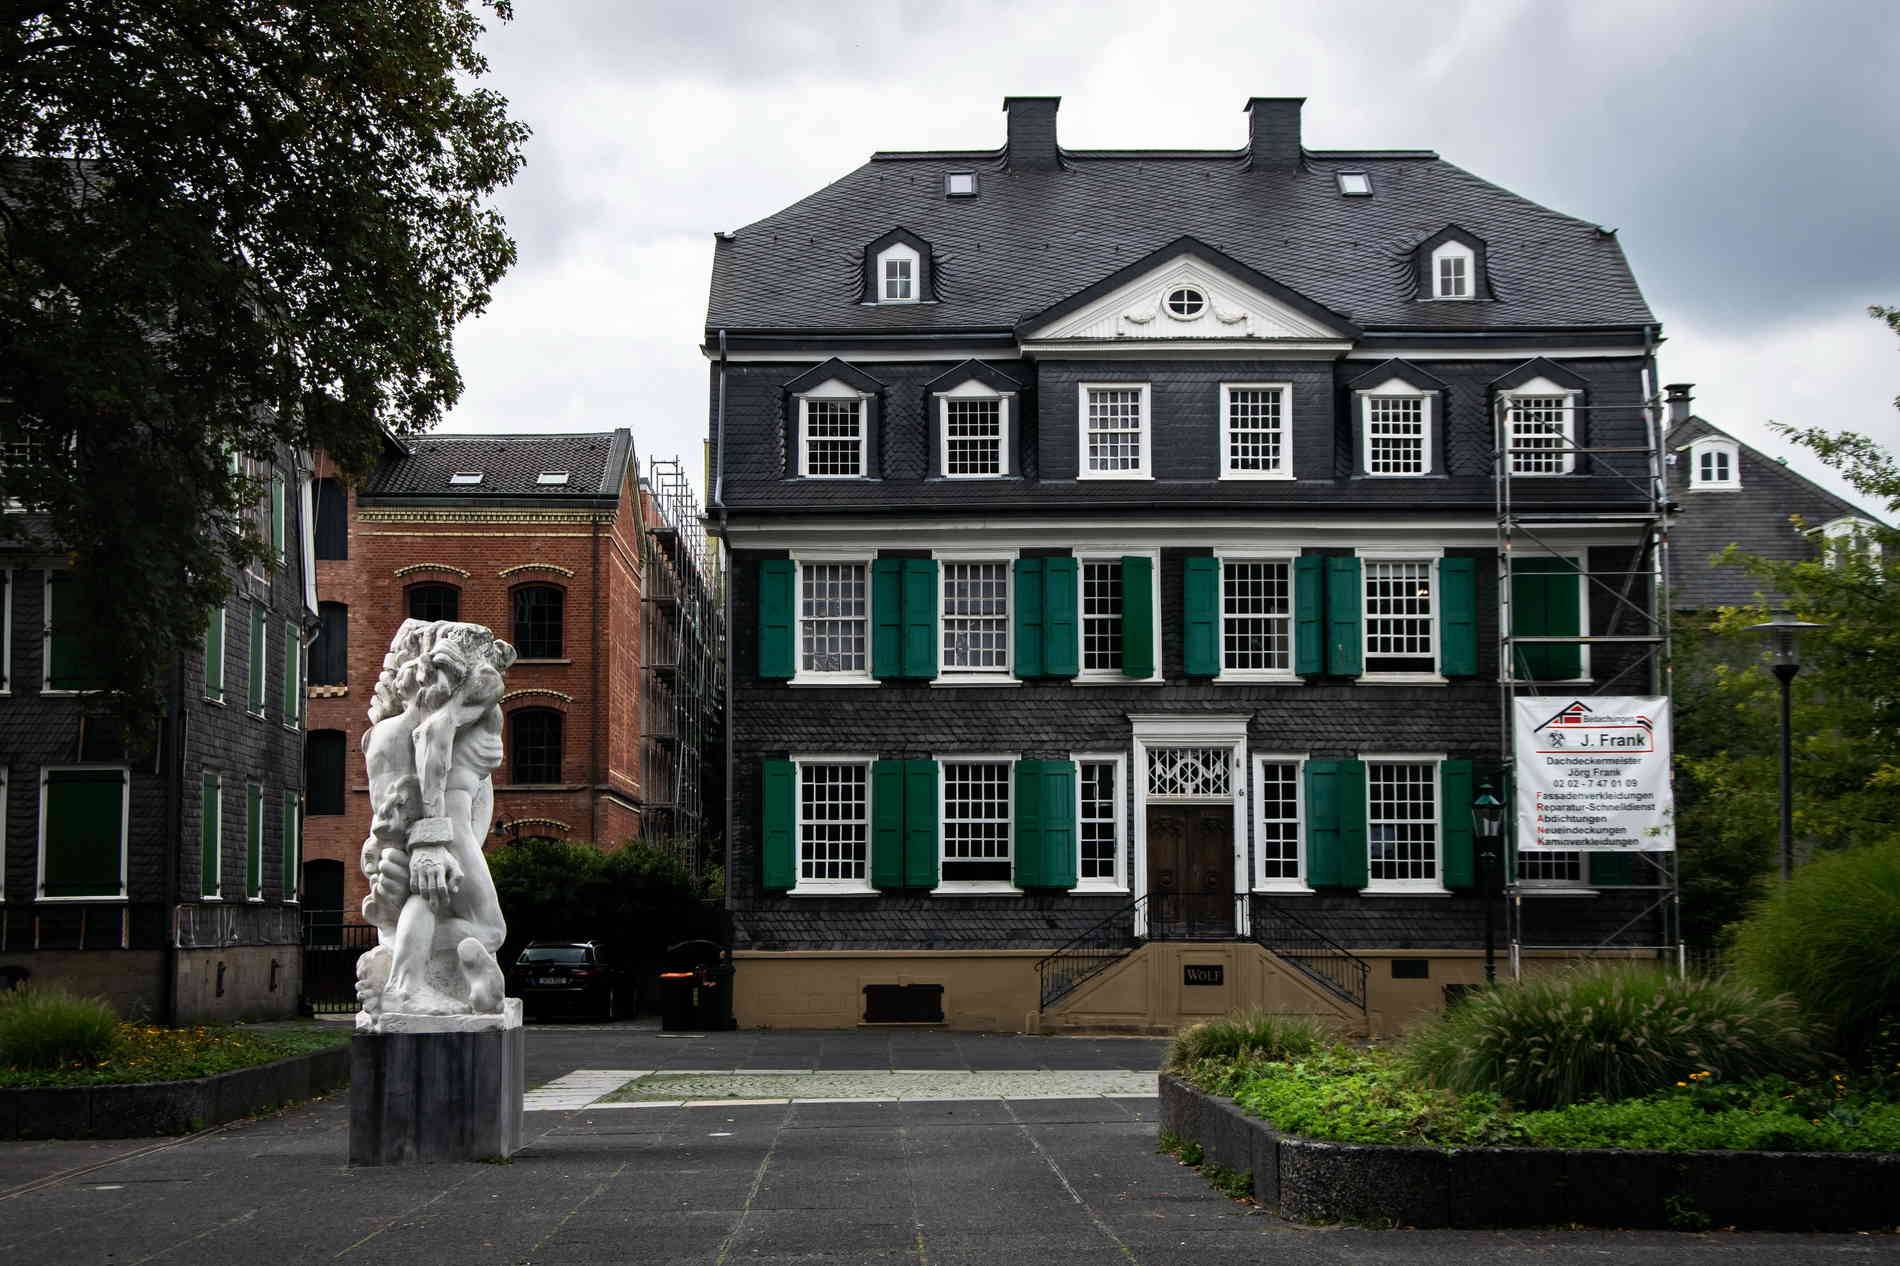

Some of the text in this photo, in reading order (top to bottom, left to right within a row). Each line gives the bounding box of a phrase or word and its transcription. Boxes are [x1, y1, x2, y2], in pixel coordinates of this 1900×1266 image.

[1580, 734, 1645, 746] J. Frank
[1546, 757, 1641, 765] Dachdeckermeister
[1568, 768, 1621, 778] Jörg Frank
[1553, 779, 1565, 788] 02
[1567, 779, 1579, 788] 02
[1587, 779, 1593, 788] 7
[1597, 779, 1608, 788] 47
[1611, 779, 1622, 788] 01
[1536, 792, 1654, 801] Fassadenverkleidungen
[1536, 803, 1656, 813] Reparatur-Schnelldienst
[1537, 815, 1607, 825] Abdichtungen
[1537, 826, 1627, 836] Neueindeckungen
[1536, 839, 1639, 847] Kaminverkleidungen
